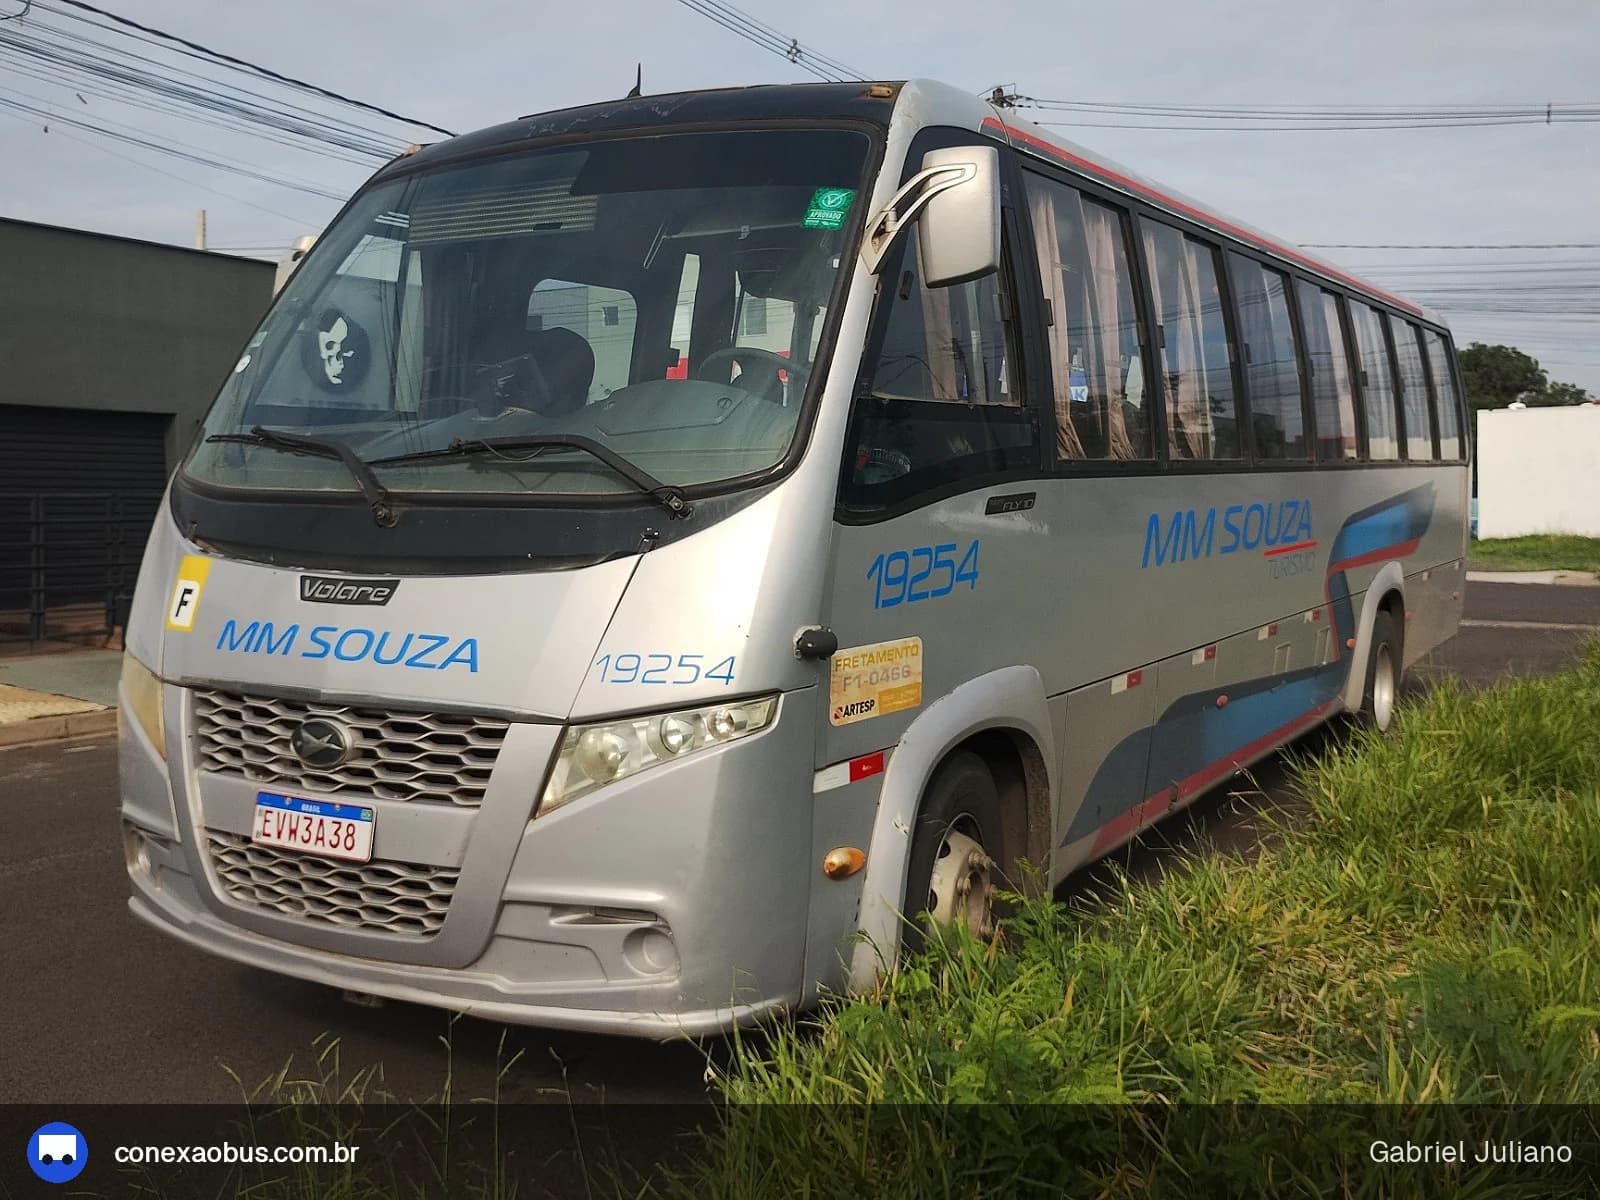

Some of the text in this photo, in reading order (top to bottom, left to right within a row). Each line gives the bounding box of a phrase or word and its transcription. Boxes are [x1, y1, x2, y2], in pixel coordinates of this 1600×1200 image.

[1142, 499, 1312, 568] MM SOUZA
[303, 578, 391, 602] Volare
[866, 539, 980, 609] 19254
[175, 588, 193, 617] F
[216, 619, 479, 673] MM SOUZA
[834, 644, 919, 672] FRETAMENTO
[596, 653, 736, 686] 19254
[843, 699, 875, 718] ARTESP
[262, 810, 356, 851] EVW3A38
